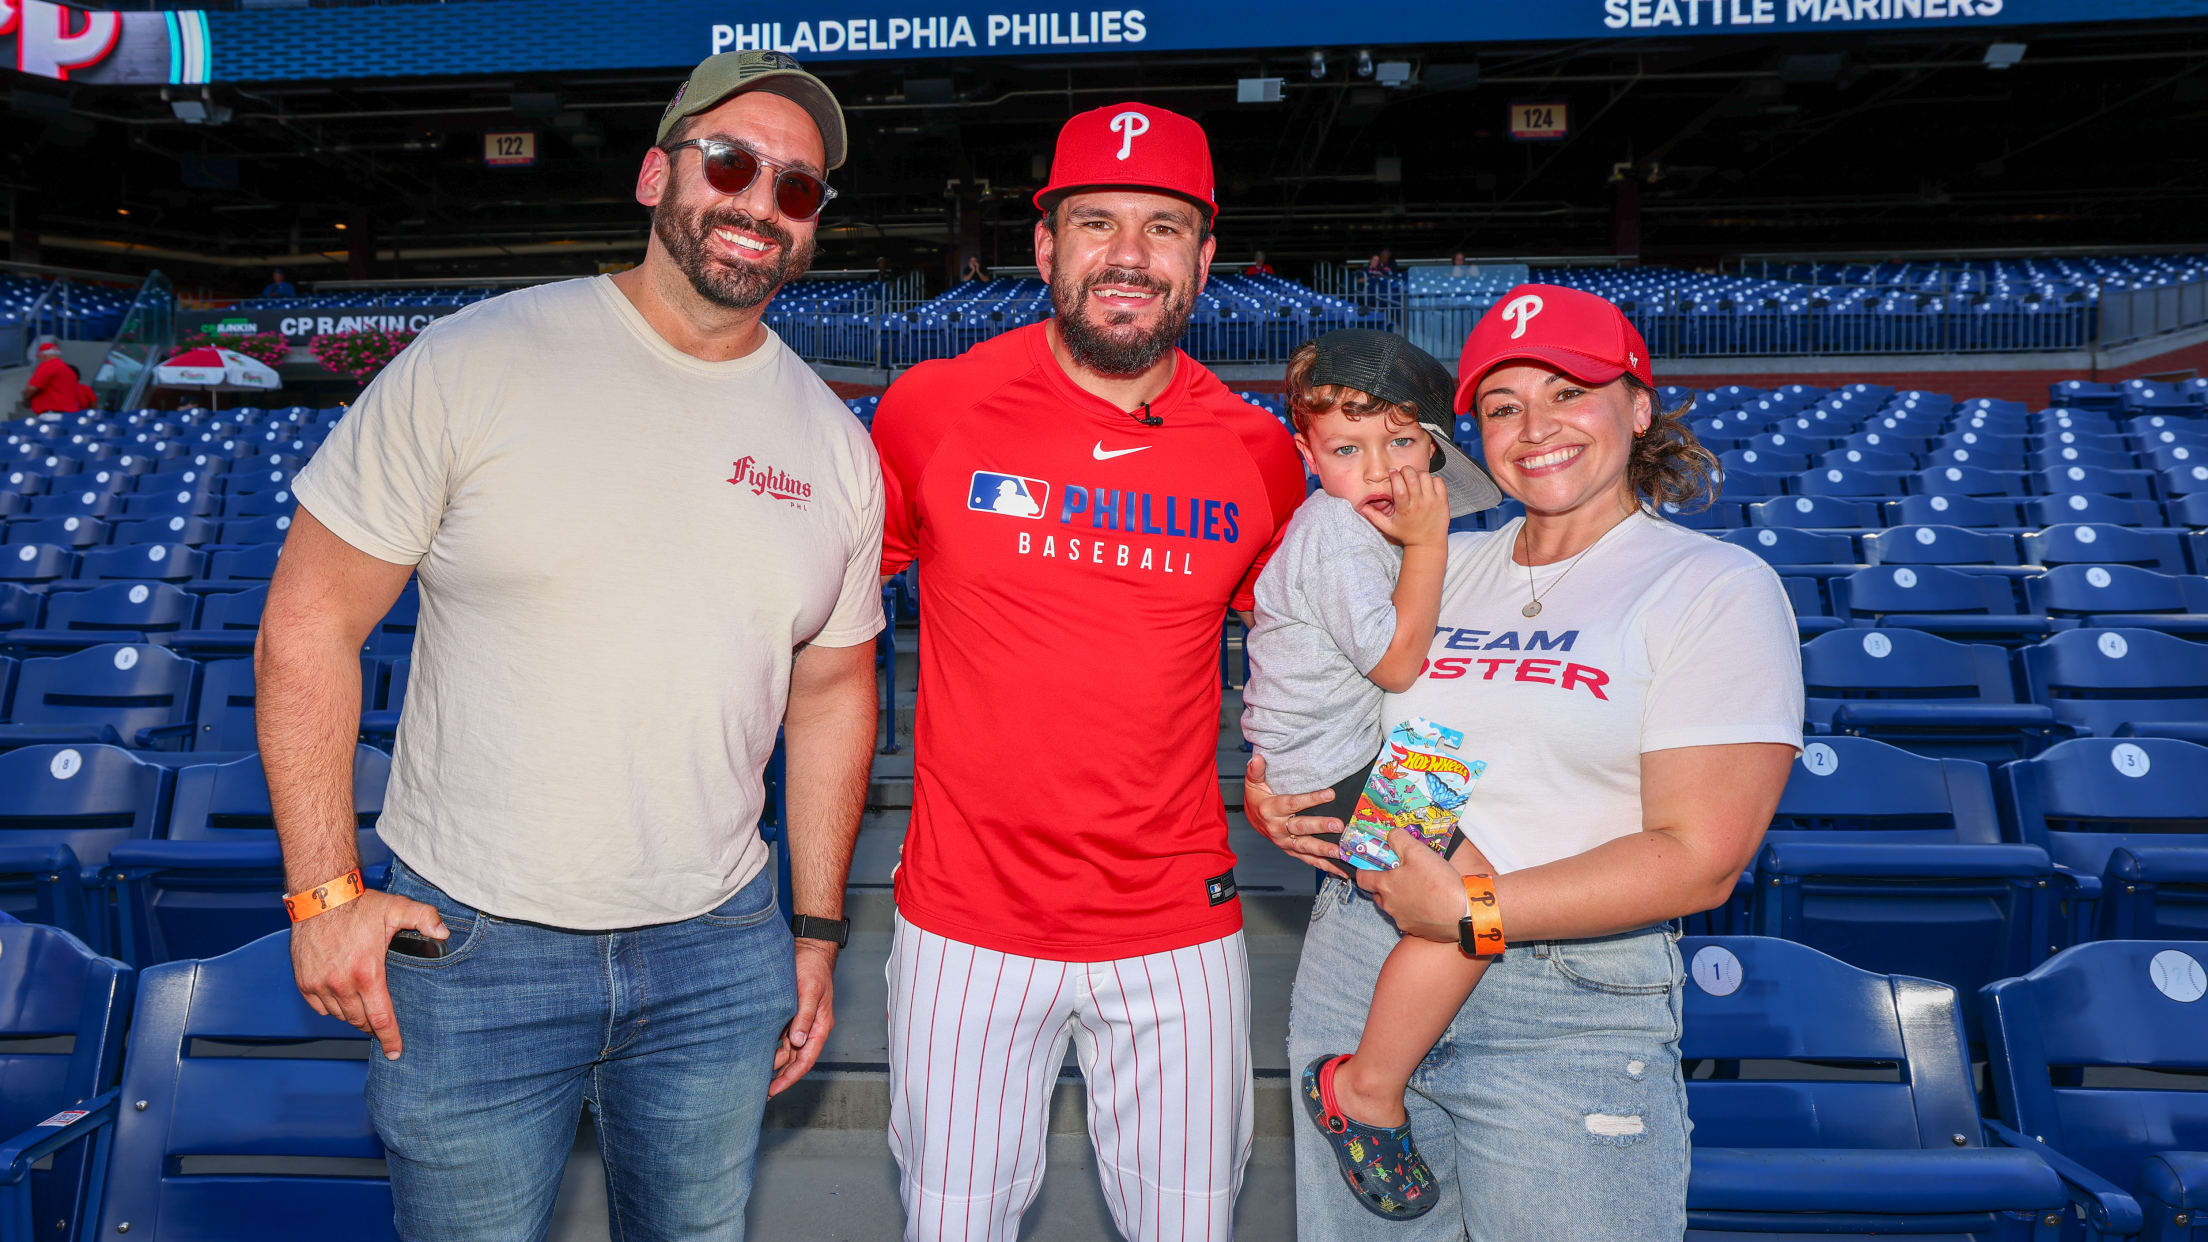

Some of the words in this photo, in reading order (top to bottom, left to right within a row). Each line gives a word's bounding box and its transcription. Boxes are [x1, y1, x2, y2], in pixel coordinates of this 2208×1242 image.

[1603, 0, 1776, 29] SEATTLE
[1786, 0, 2004, 23] MARINERS
[711, 16, 977, 55] PHILADELPHIA
[987, 10, 1147, 46] PHILLIES
[1524, 107, 1554, 128] 124
[496, 136, 523, 156] 122
[1110, 111, 1150, 161] P
[280, 317, 314, 336] CP
[317, 315, 405, 336] RANKIN
[1502, 294, 1544, 340] P
[726, 455, 811, 498] Fightins
[790, 501, 808, 512] PHL
[1060, 484, 1240, 544] PHILLIES
[1018, 532, 1193, 576] BASEBALL
[1401, 751, 1431, 770] HOT
[1815, 752, 1824, 766] 2
[2127, 754, 2136, 767] 3
[312, 887, 328, 909] P
[1713, 962, 1720, 980] 1
